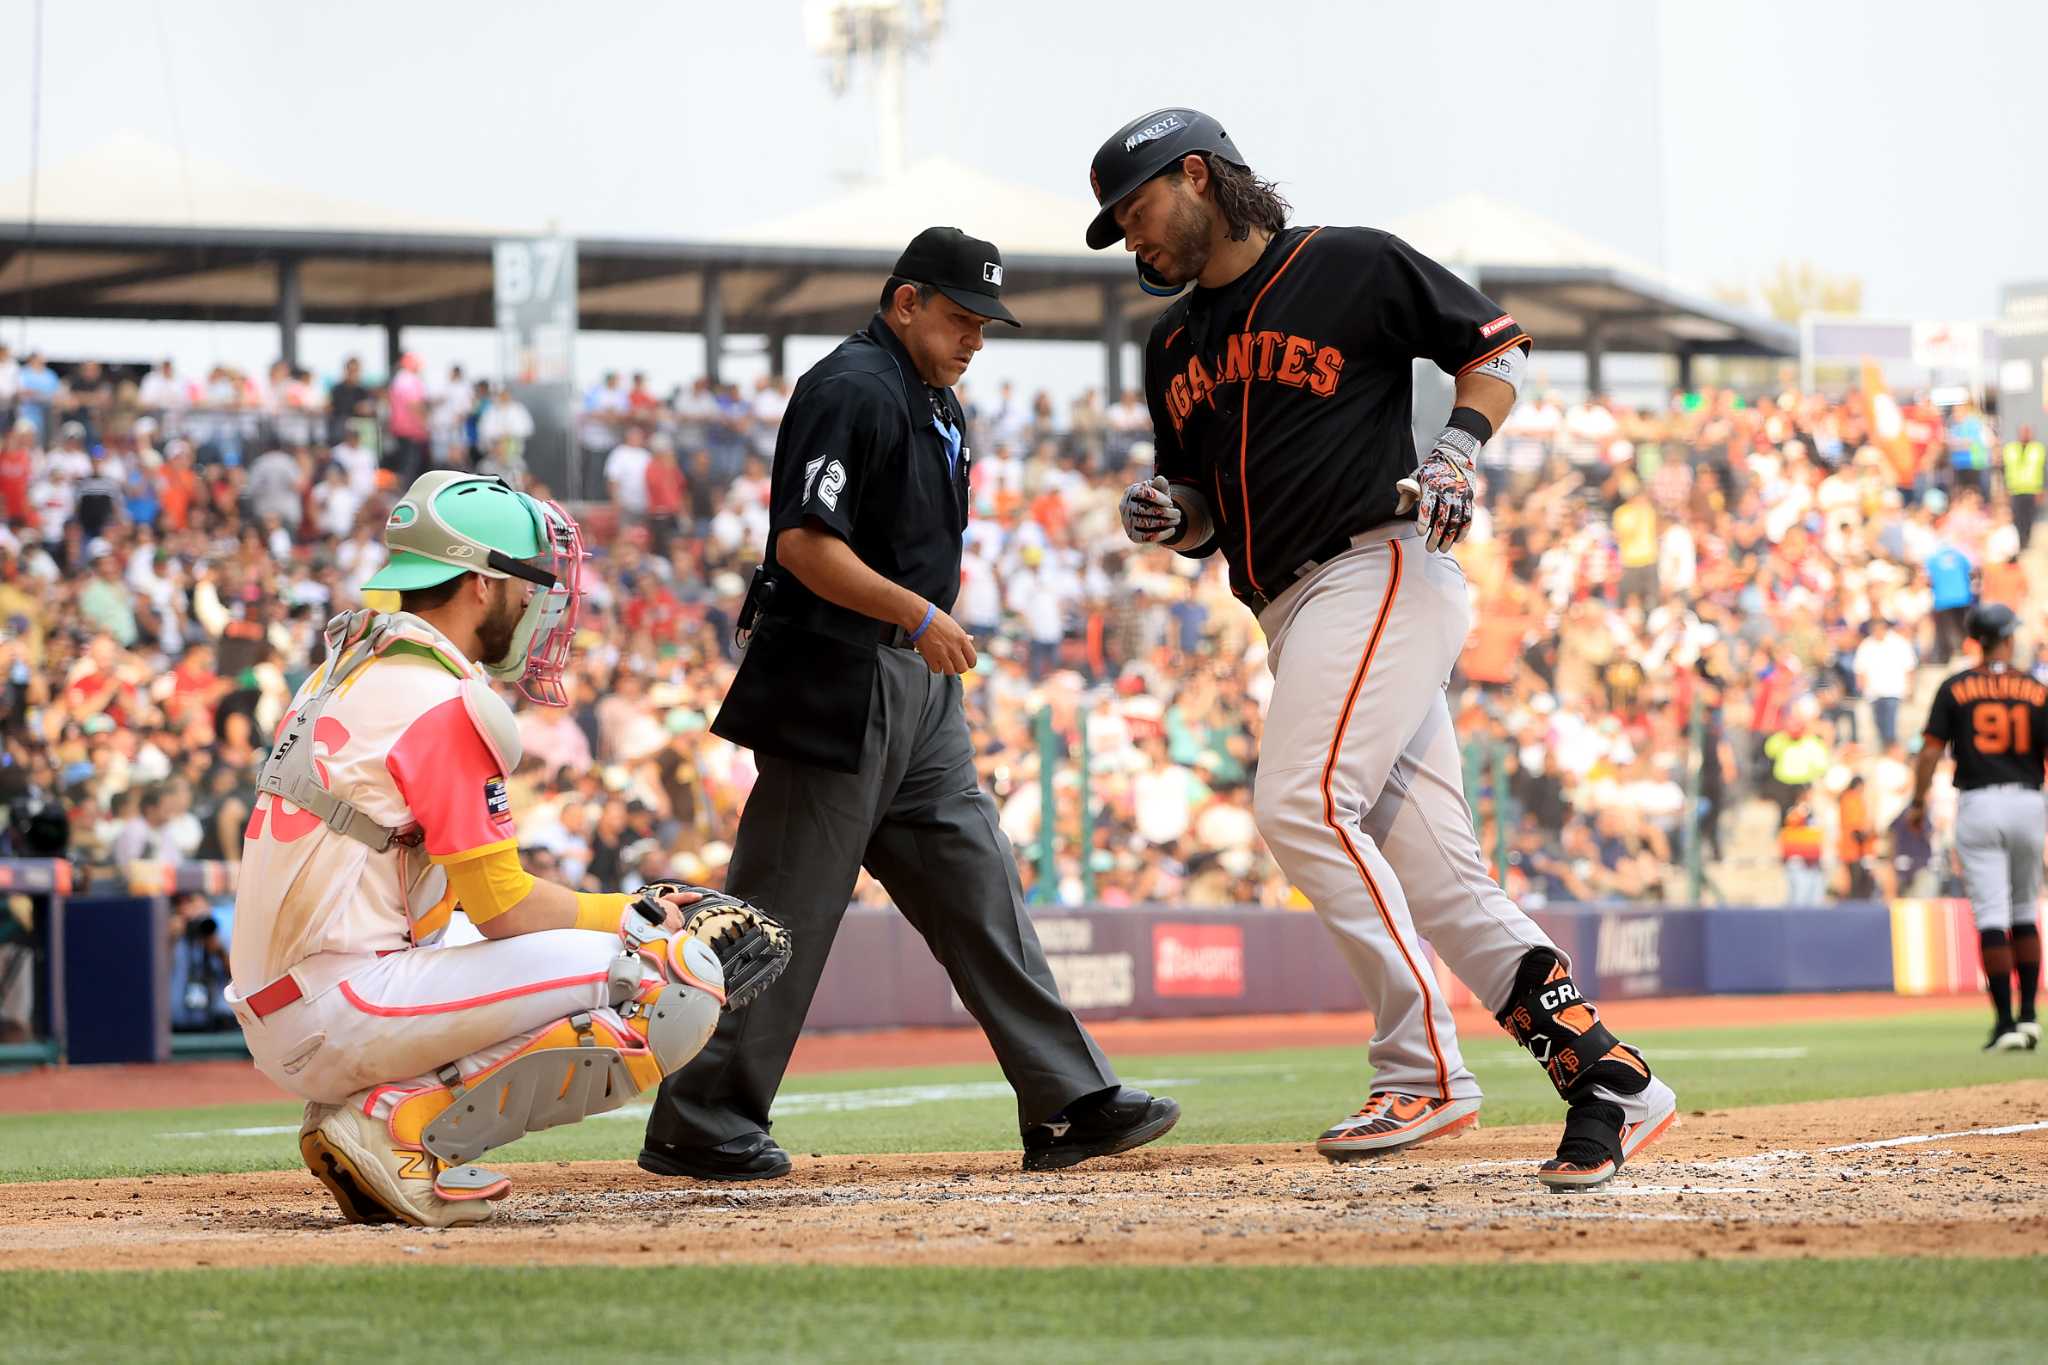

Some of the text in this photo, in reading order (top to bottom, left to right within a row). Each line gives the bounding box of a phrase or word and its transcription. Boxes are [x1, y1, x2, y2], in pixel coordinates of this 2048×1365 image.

[497, 242, 566, 301] B7
[801, 454, 847, 513] 72
[1973, 703, 2031, 754] 91
